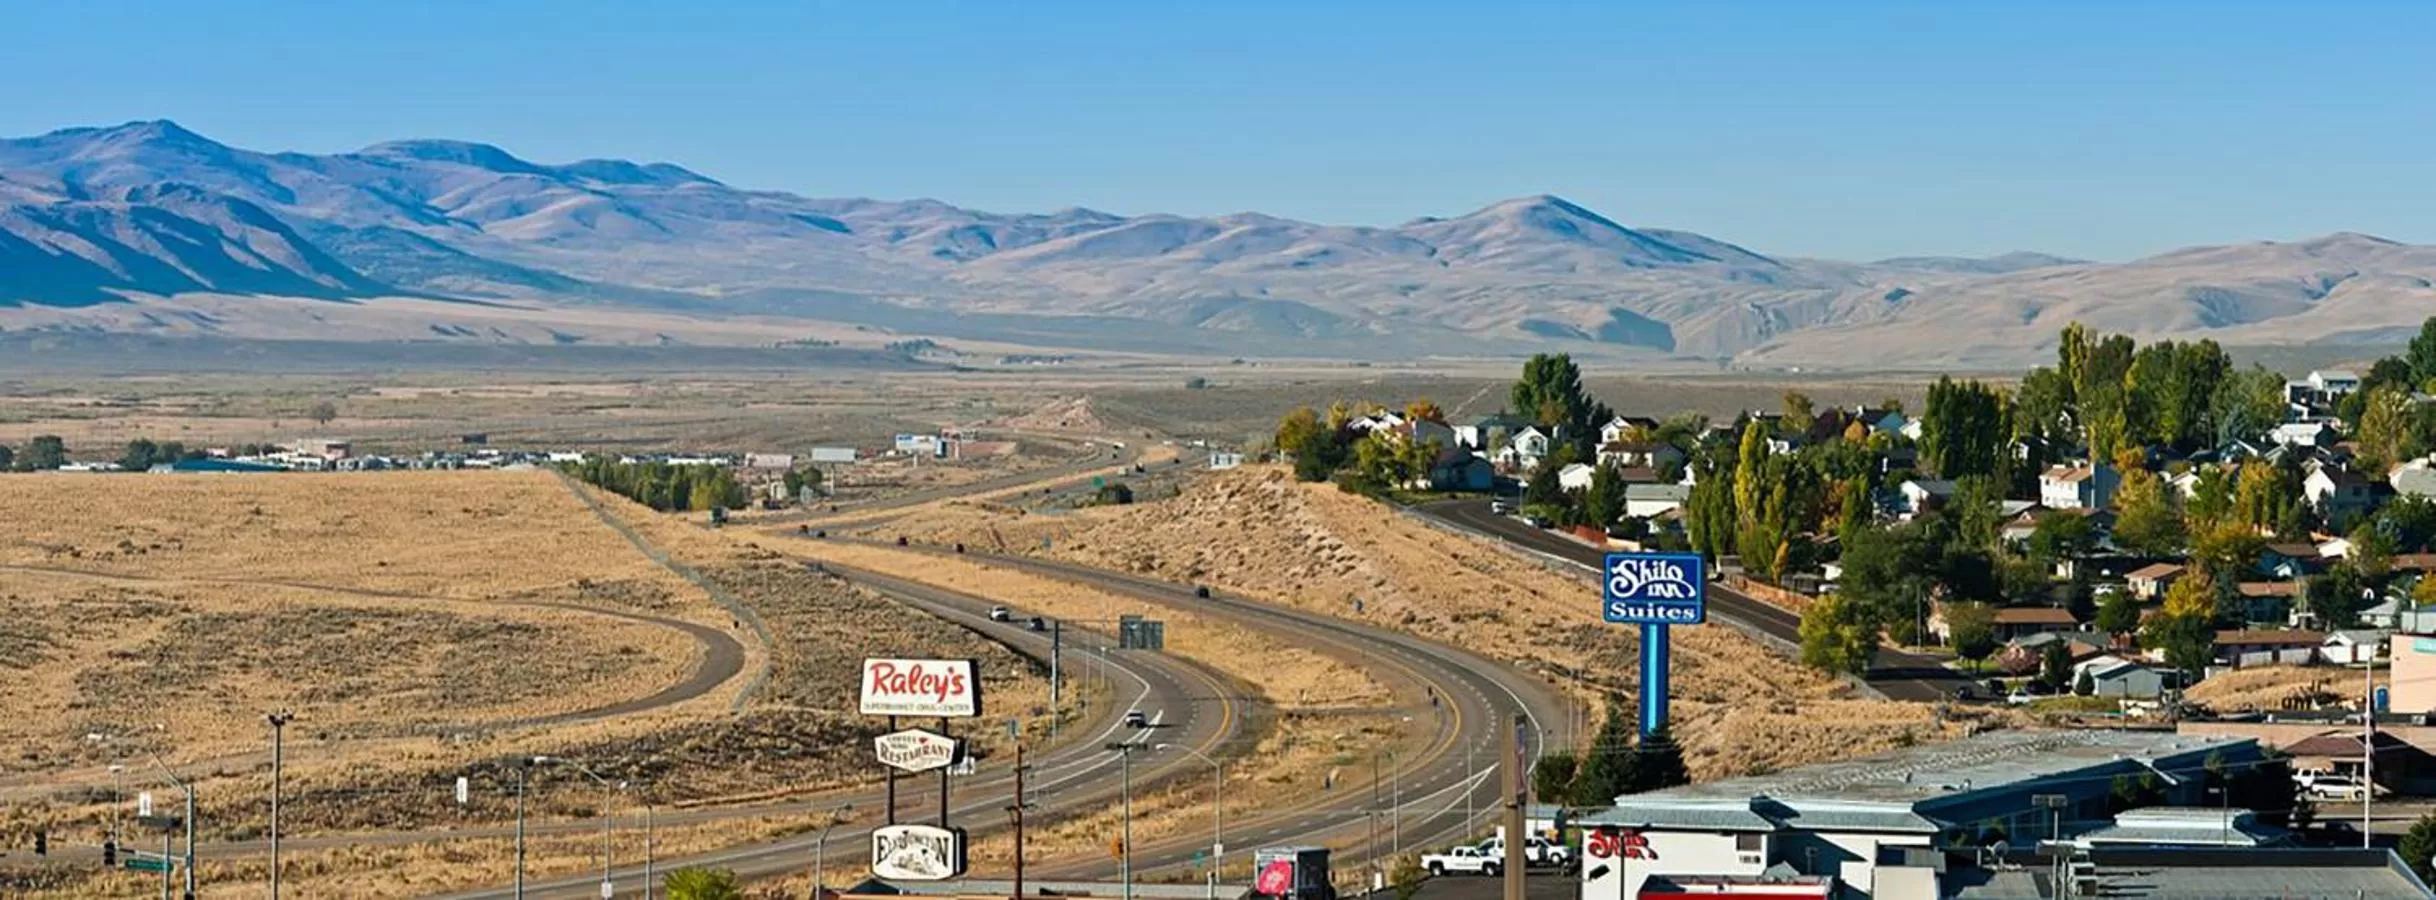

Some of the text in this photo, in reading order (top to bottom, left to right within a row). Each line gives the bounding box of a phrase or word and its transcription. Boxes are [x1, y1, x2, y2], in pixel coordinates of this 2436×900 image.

[1610, 559, 1695, 598] Shilo
[1610, 602, 1696, 620] Suites
[869, 662, 965, 703] Raley's
[880, 742, 951, 764] RESTAURANT
